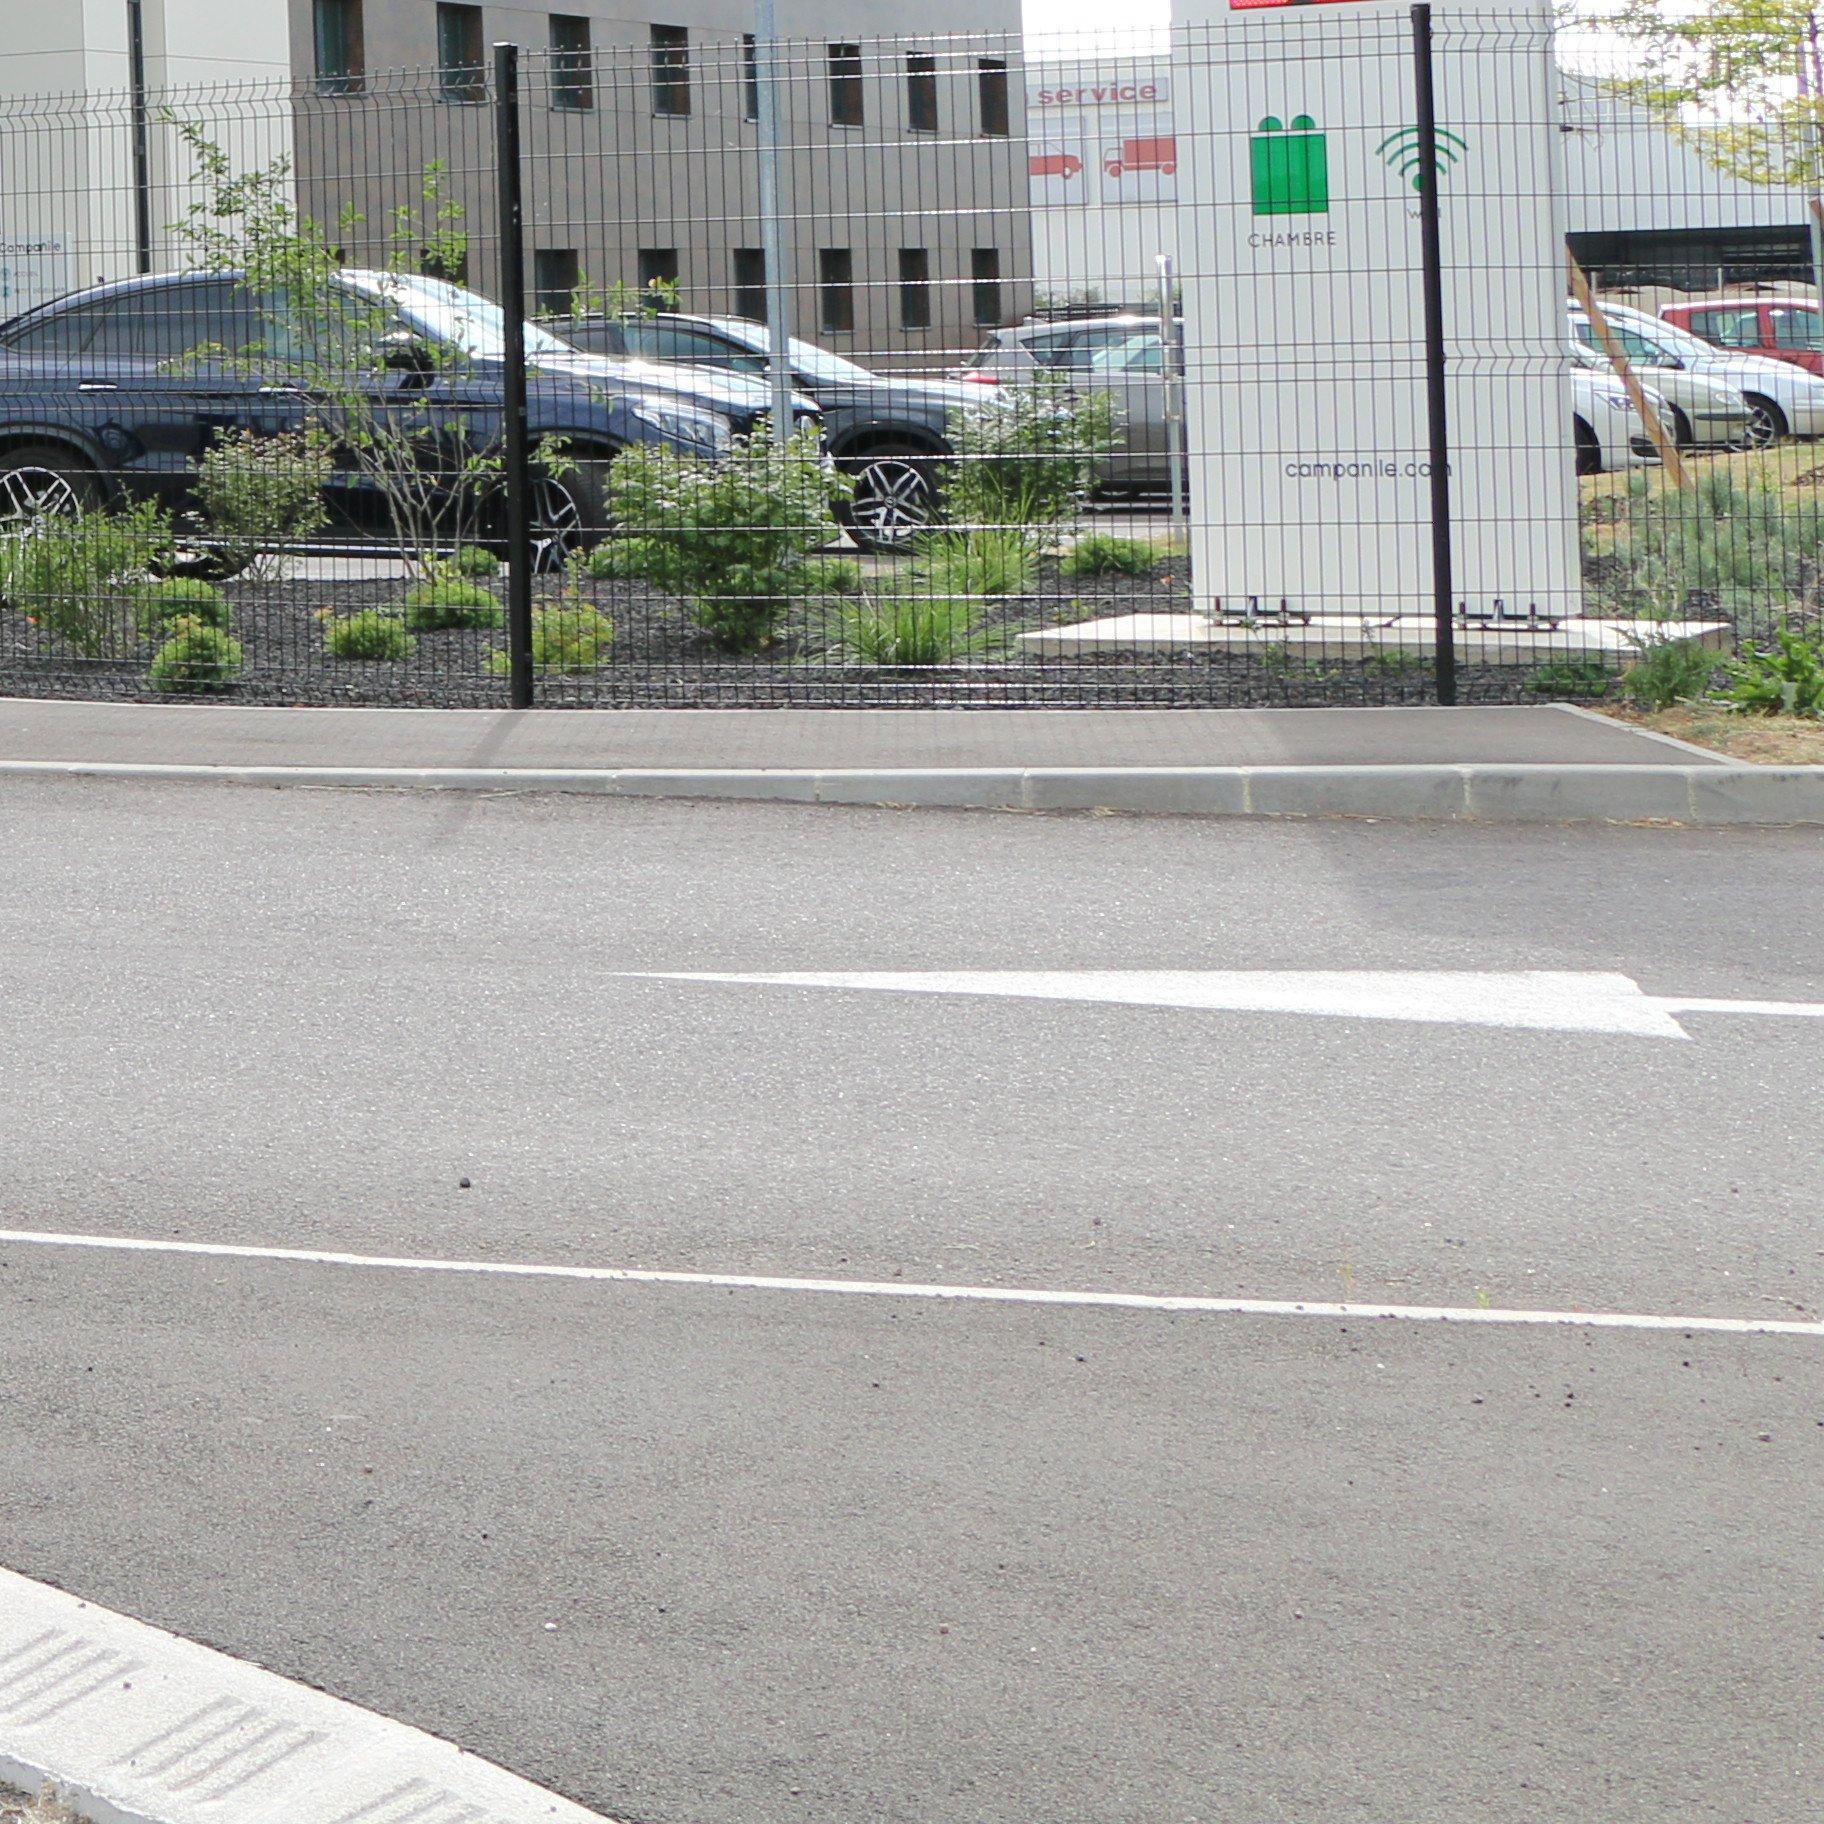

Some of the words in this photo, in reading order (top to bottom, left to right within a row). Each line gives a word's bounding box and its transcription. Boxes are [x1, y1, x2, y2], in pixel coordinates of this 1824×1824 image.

[1038, 82, 1157, 105] service
[1247, 230, 1337, 248] CHAMBRE
[1285, 458, 1452, 481] campanle.co
